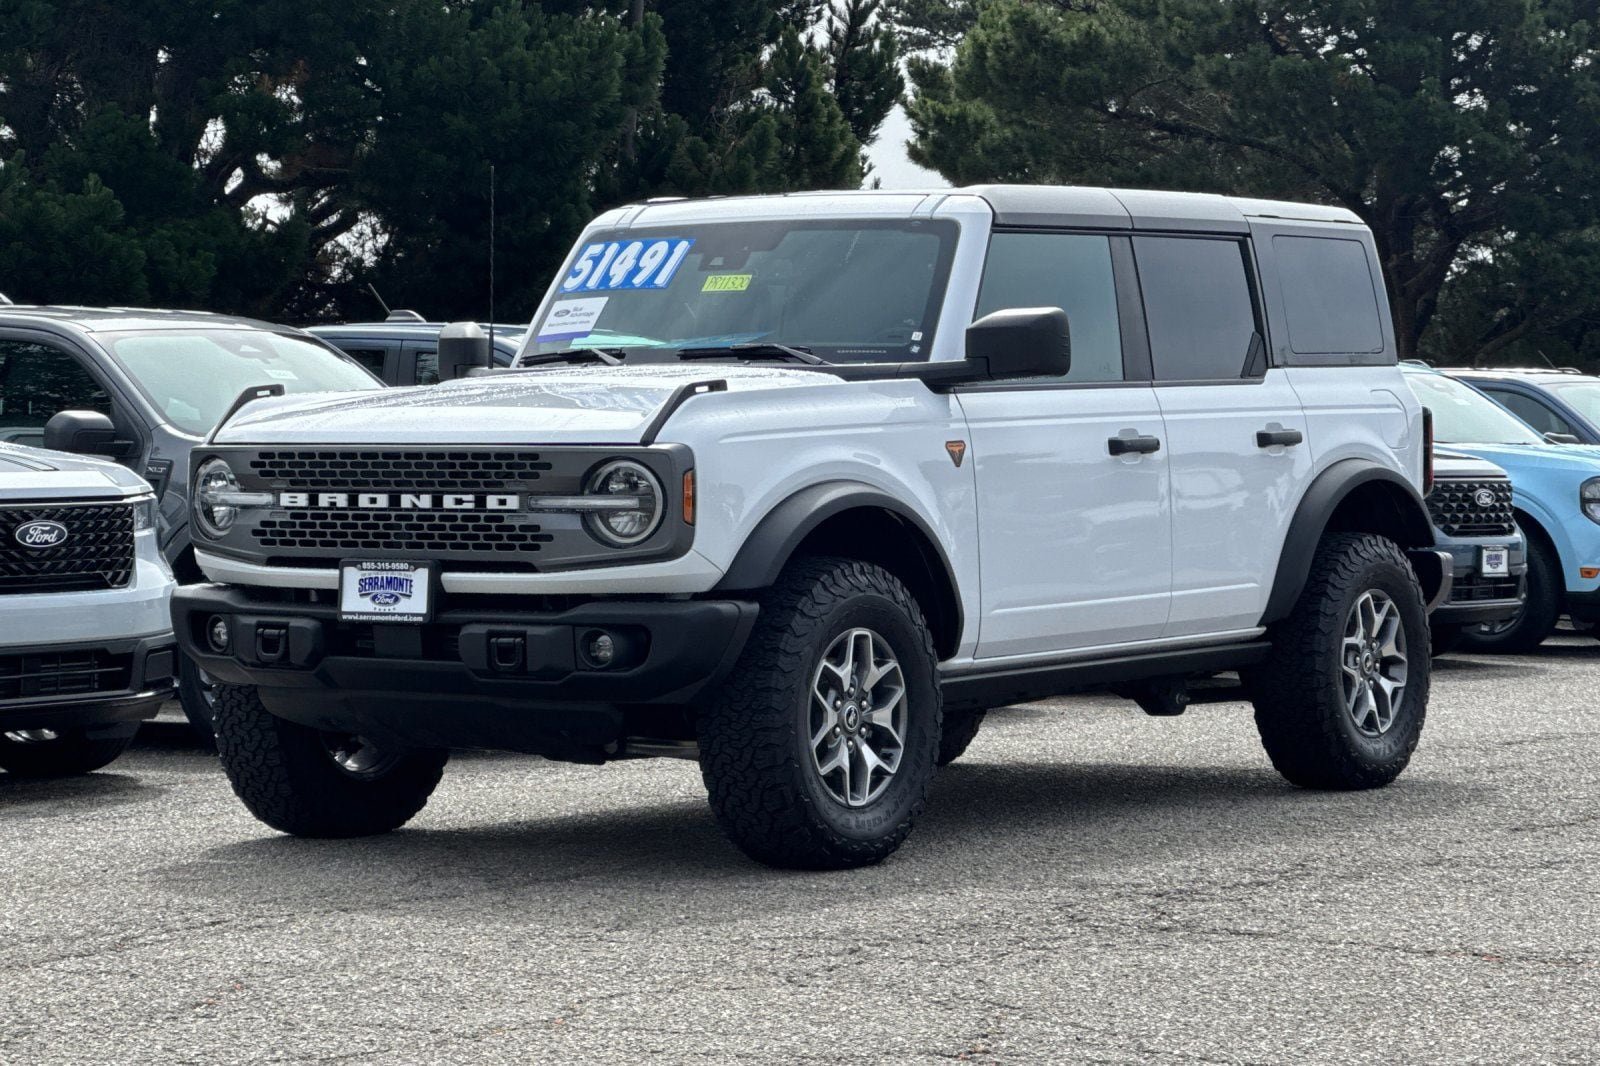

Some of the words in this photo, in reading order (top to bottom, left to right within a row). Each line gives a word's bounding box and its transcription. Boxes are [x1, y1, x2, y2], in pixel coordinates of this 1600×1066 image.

[563, 240, 690, 291] 51491
[279, 492, 520, 510] BRONCO
[26, 526, 57, 543] Ford
[358, 576, 414, 594] SERRAMONTE
[375, 593, 396, 604] Ford
[342, 613, 423, 622] www.serramonteford.com
